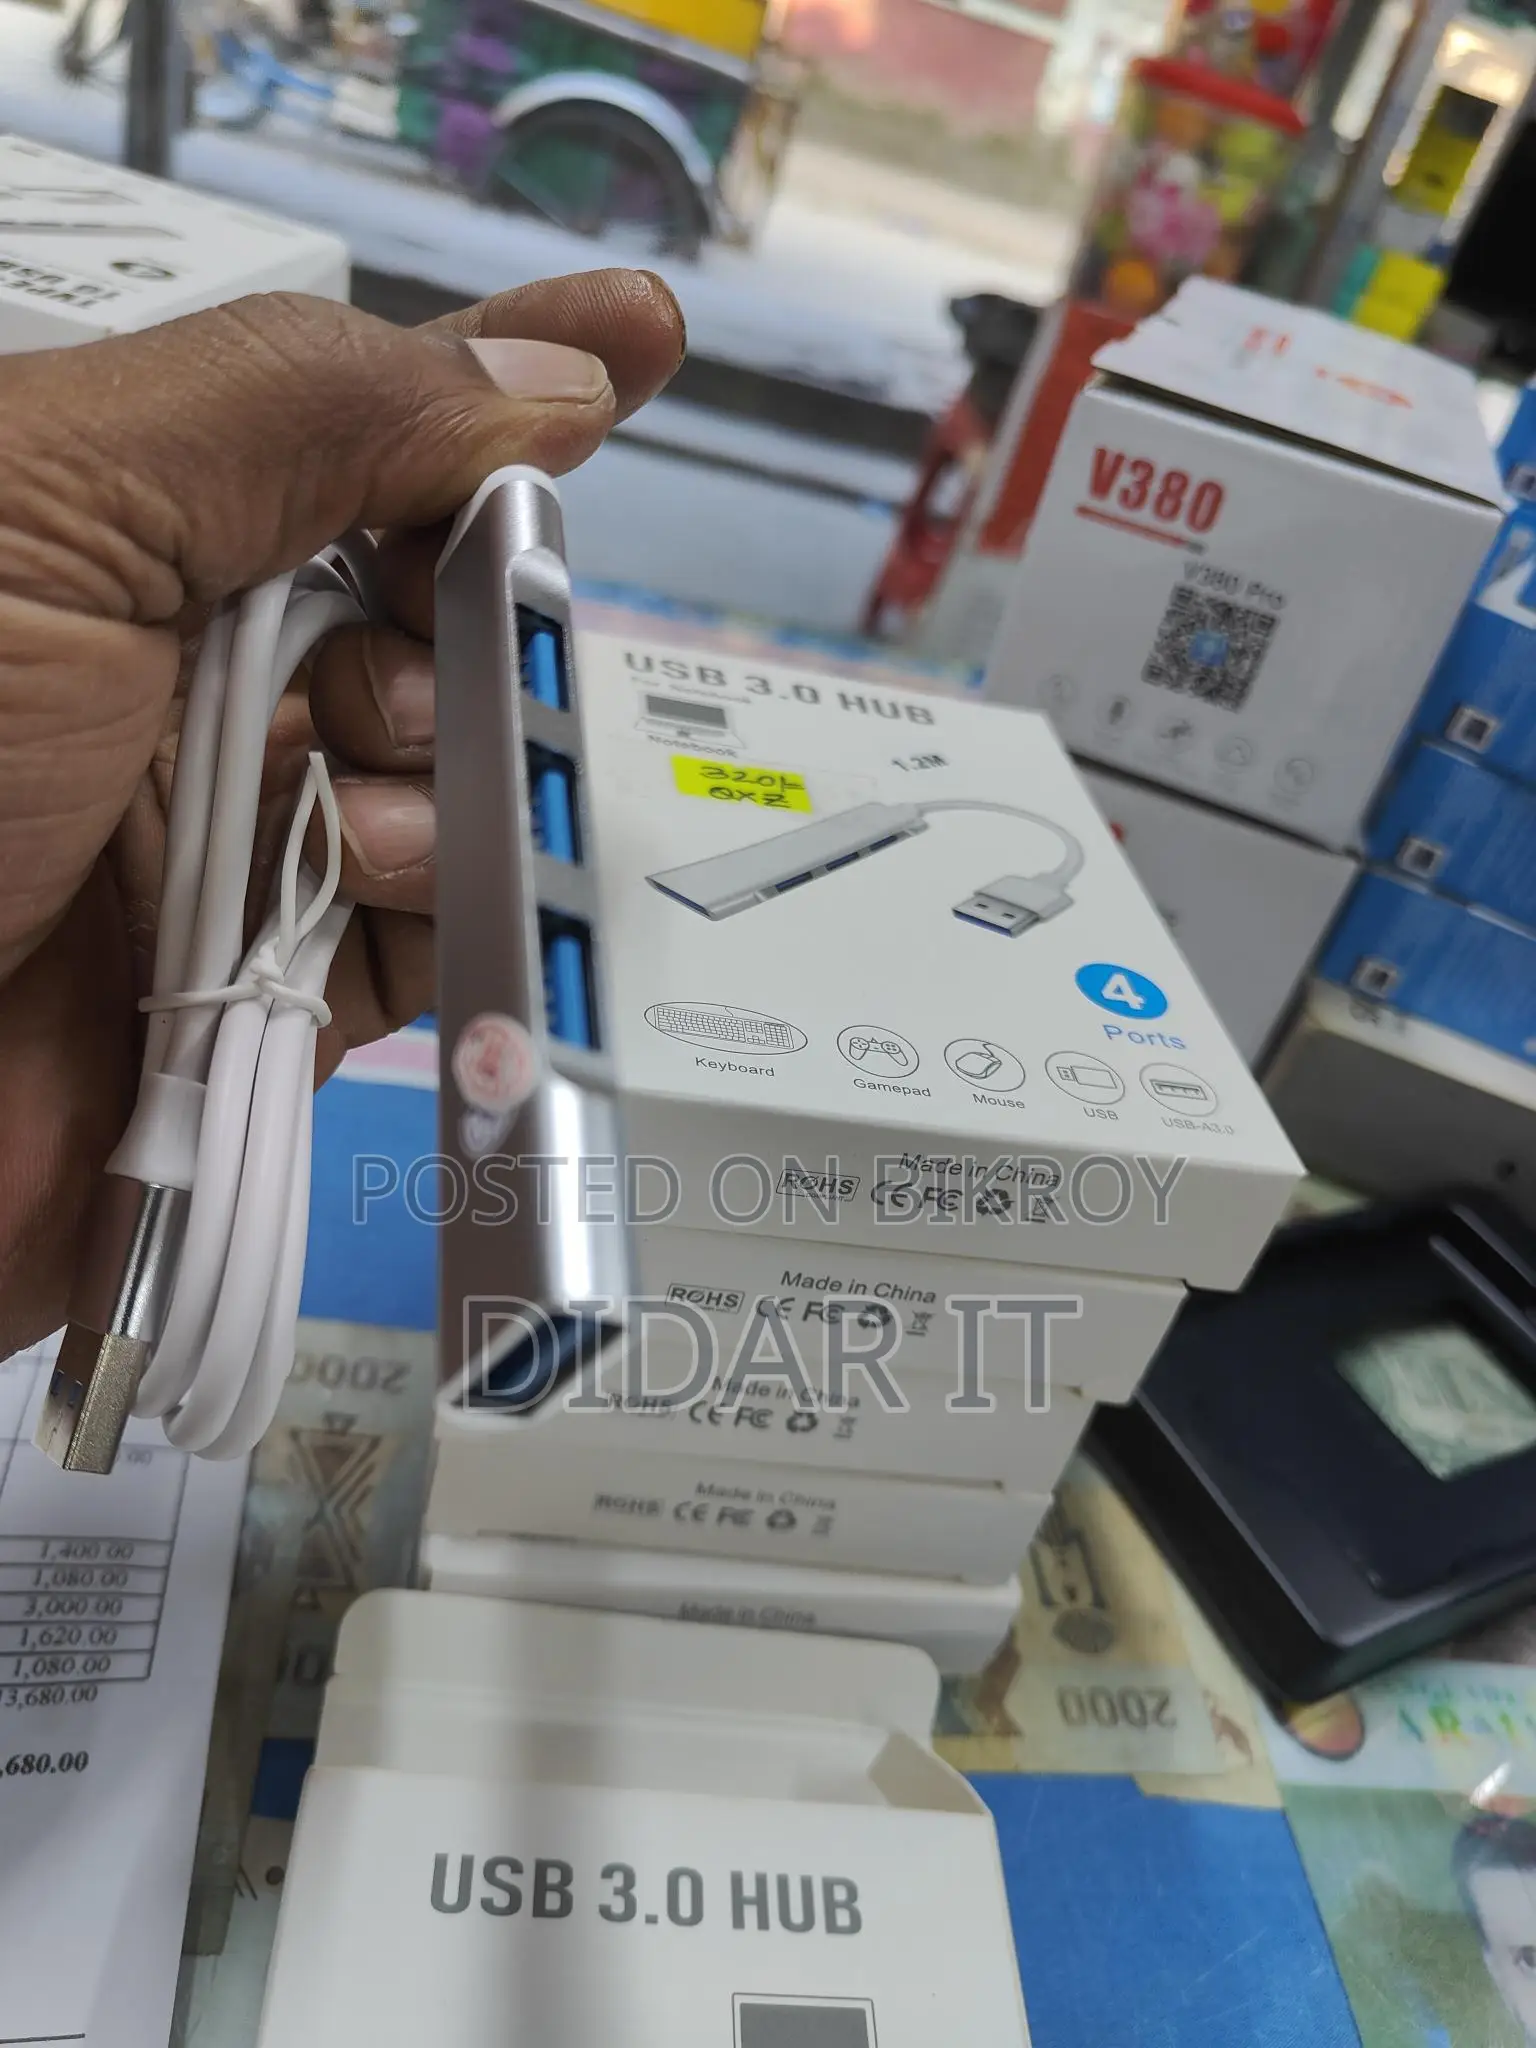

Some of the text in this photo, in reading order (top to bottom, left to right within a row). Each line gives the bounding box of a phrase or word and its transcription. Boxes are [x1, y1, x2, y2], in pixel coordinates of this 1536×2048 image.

[1089, 447, 1226, 535] V380
[1184, 562, 1239, 596] V380
[625, 651, 936, 726] USB 3.0 HUB
[647, 734, 738, 758] Notebook
[891, 754, 949, 772] 1.2M
[1101, 972, 1146, 1011] 4
[1102, 1024, 1187, 1050] Ports
[695, 1056, 775, 1077] Keyboard
[852, 1078, 932, 1098] Gamepad
[972, 1093, 1026, 1110] Mouse
[1083, 1106, 1119, 1121] USB
[1161, 1116, 1235, 1136] USB-A3.0
[899, 1152, 1061, 1188] Made in China
[782, 1172, 855, 1195] ROHS
[670, 1286, 740, 1308] ROHS
[780, 1270, 938, 1305] Made in China
[712, 1375, 861, 1409] Made in China
[695, 1481, 837, 1511] Made in China
[40, 1540, 135, 1563] 1,400.00
[32, 1567, 129, 1590] 1,080.00
[23, 1595, 123, 1619] 3,000.00
[20, 1626, 119, 1650] 1,620.00
[13, 1655, 112, 1679] 1,080.00
[1056, 1686, 1178, 1729] 2000
[430, 1852, 863, 1935] USB 3.0 HUB
